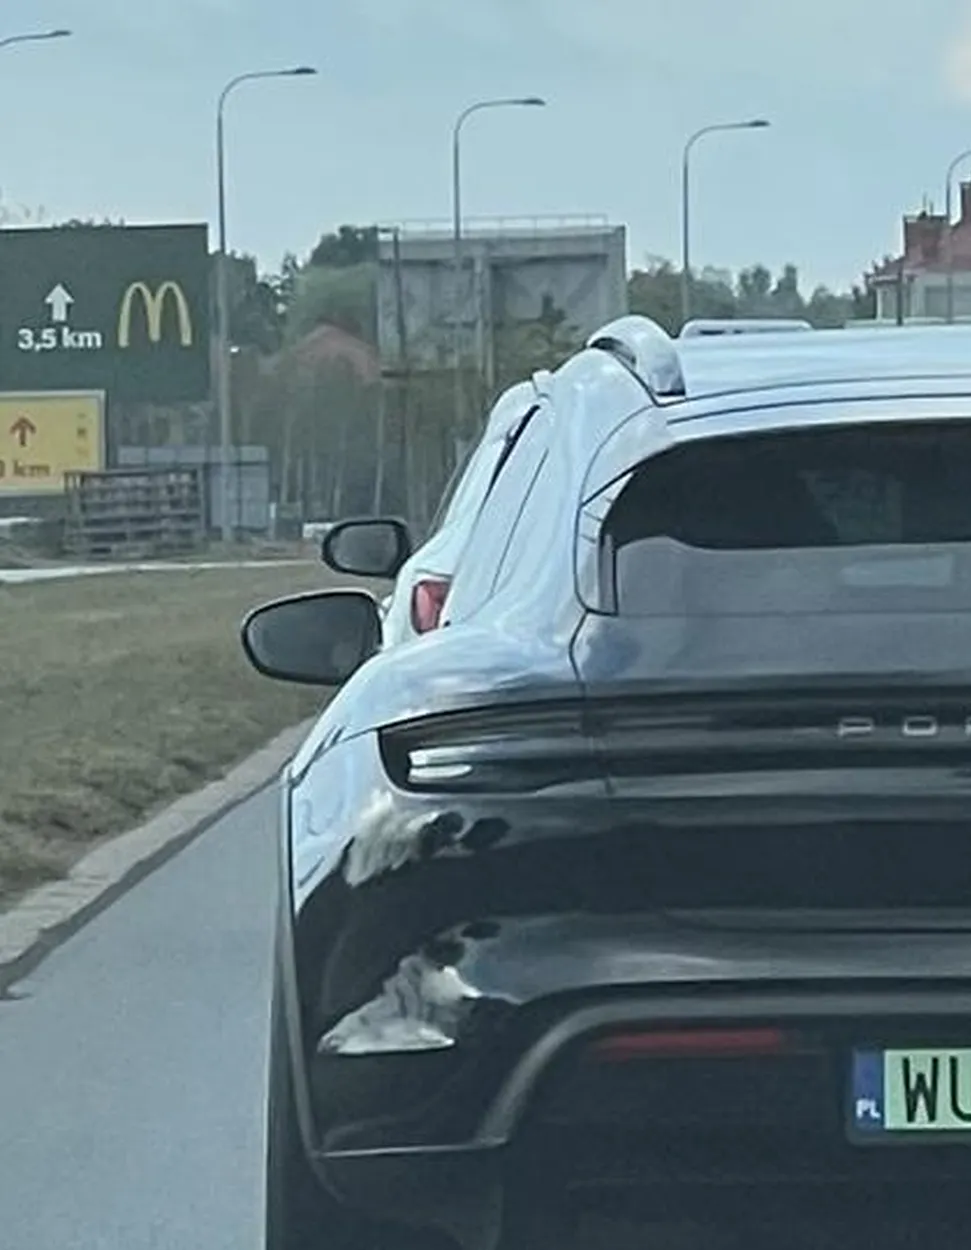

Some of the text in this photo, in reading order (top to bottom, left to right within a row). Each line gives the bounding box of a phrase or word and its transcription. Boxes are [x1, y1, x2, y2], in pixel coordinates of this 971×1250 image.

[18, 326, 102, 351] 3,5 km
[14, 460, 50, 477] km
[856, 1099, 881, 1118] PL
